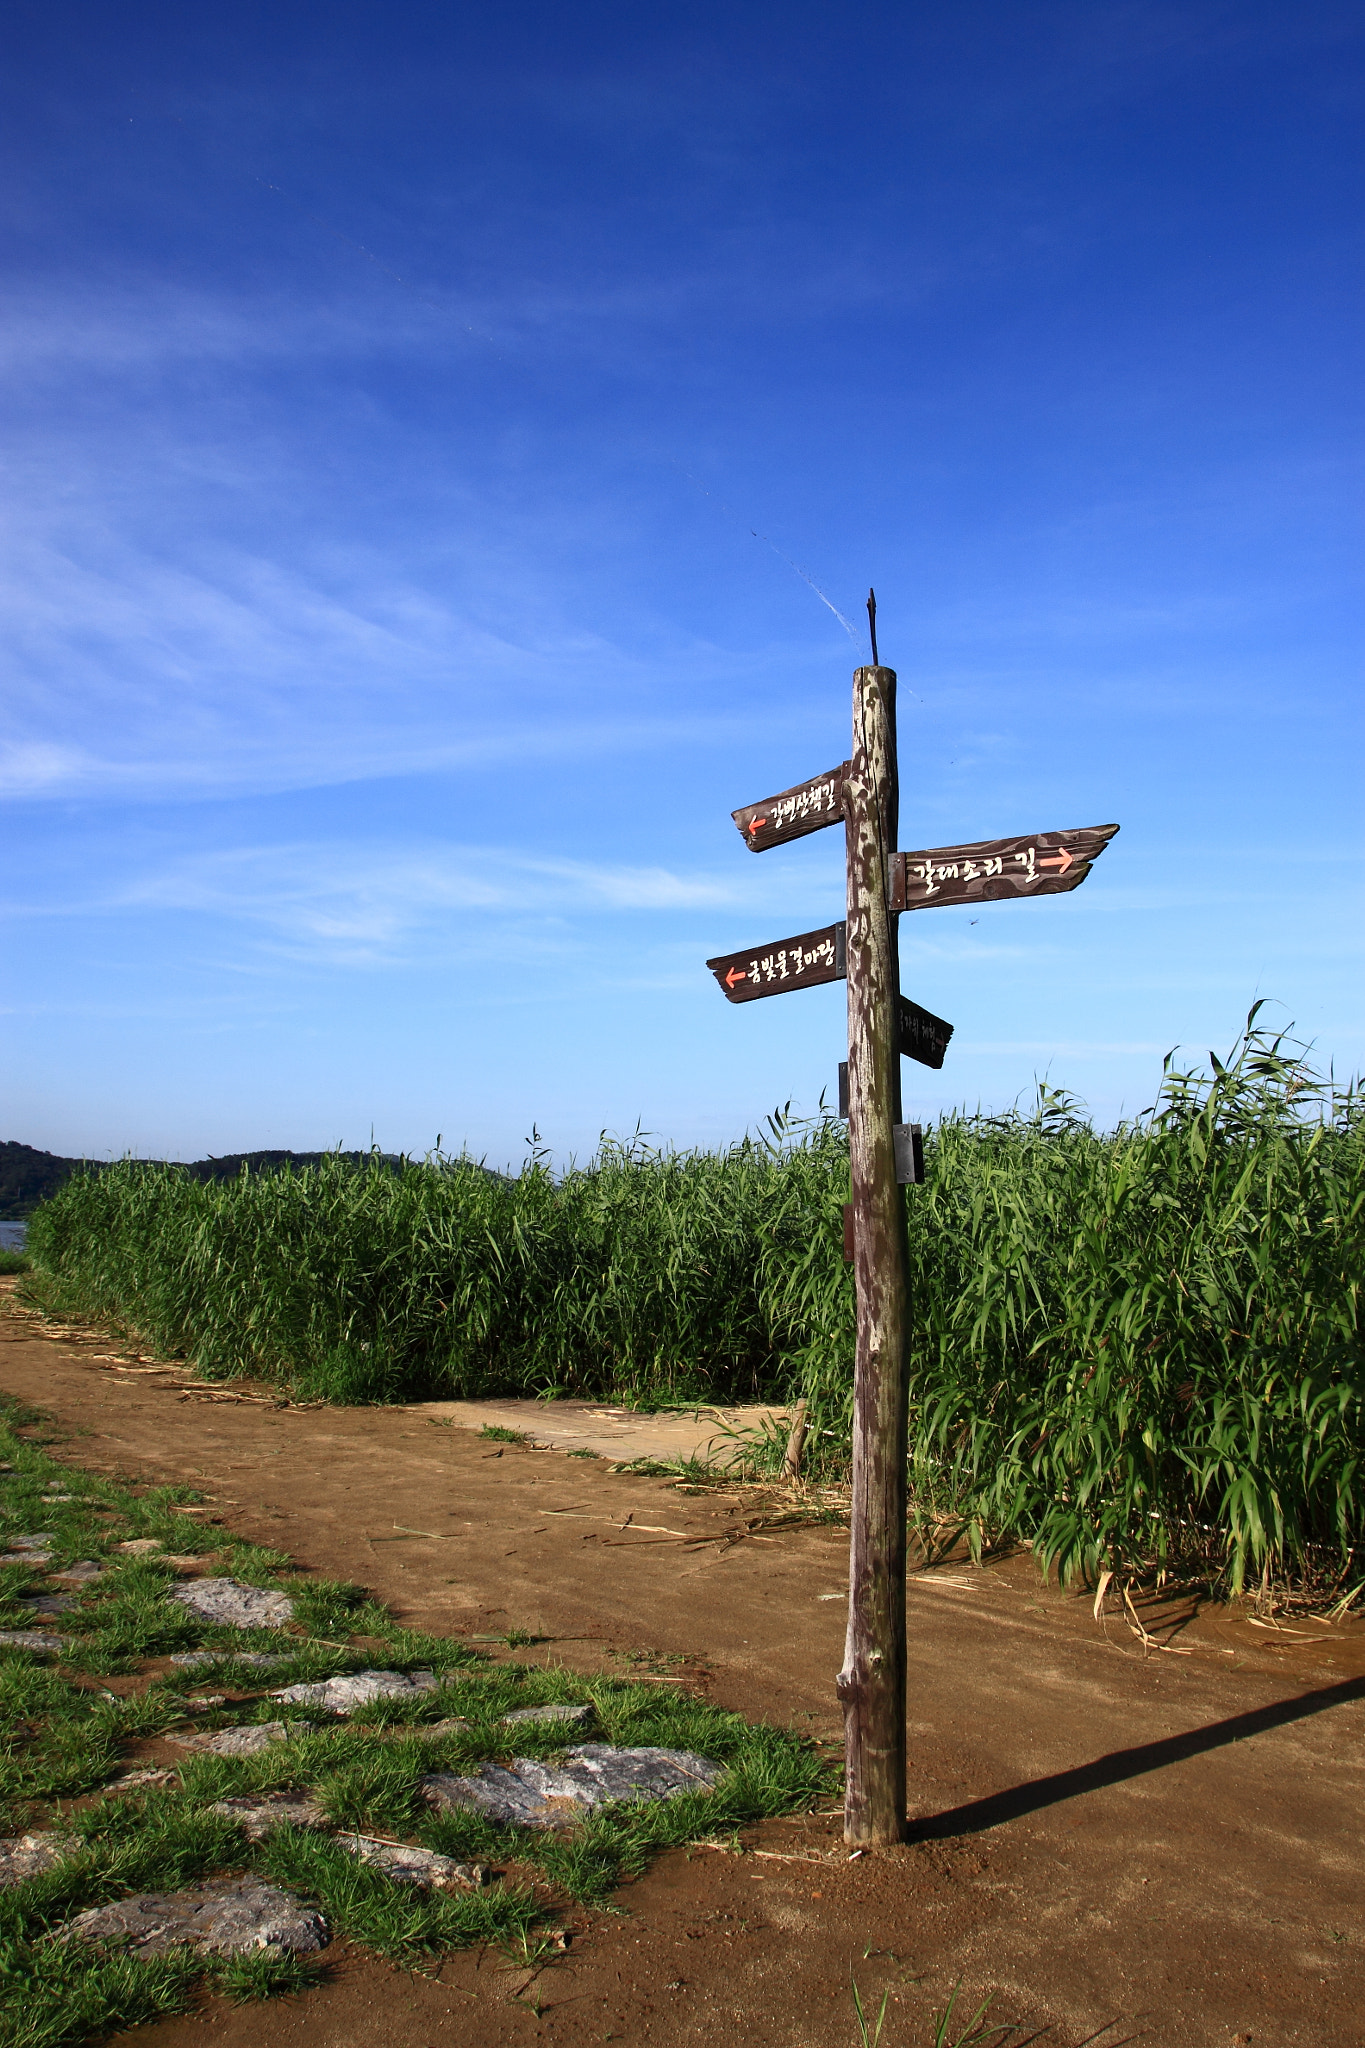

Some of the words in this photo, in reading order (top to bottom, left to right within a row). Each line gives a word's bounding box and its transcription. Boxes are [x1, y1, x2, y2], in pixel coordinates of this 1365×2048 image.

[771, 779, 836, 829] 강변산책길
[914, 857, 1003, 895] 갈대소리
[1015, 847, 1040, 884] 길
